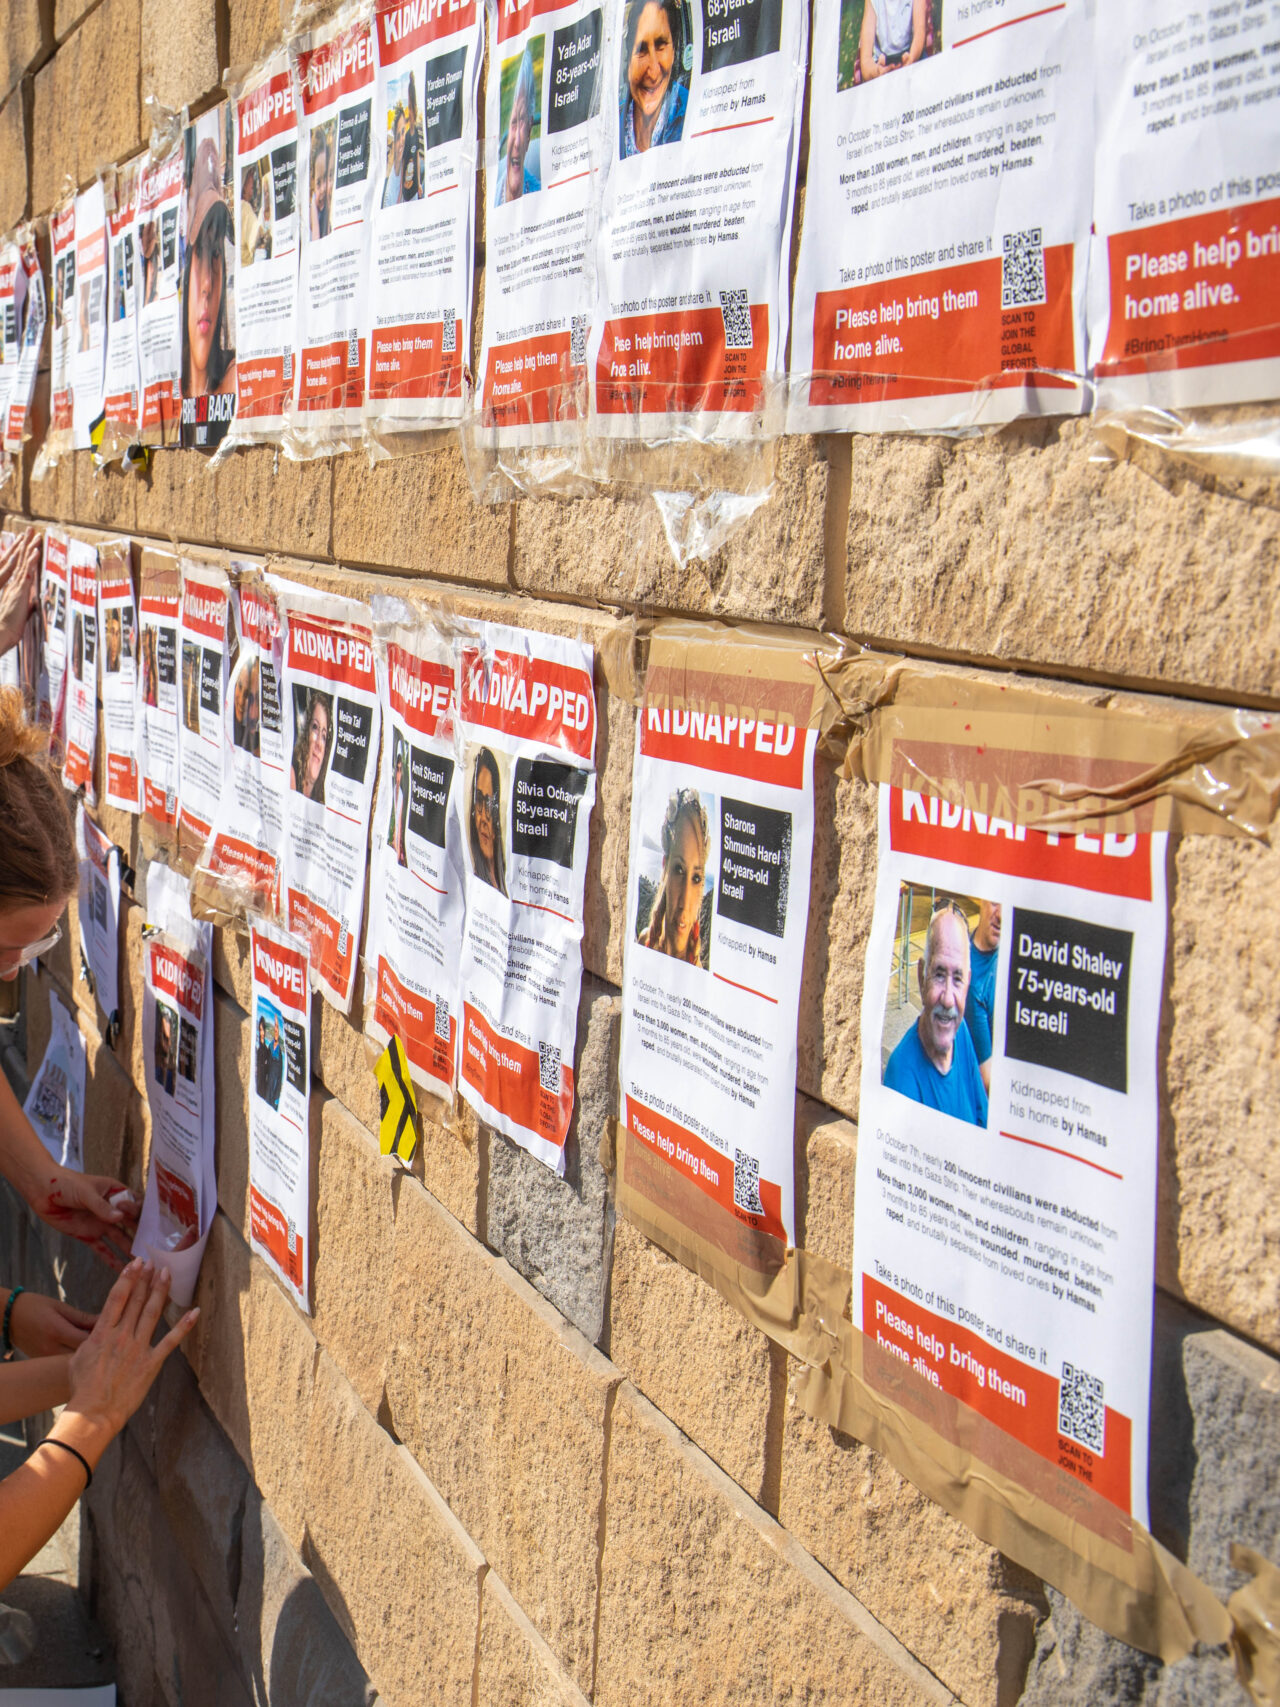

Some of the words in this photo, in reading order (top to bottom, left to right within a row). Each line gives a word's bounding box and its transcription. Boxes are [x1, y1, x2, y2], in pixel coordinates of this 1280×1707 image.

[558, 43, 576, 60] Yafa
[577, 34, 592, 52] Adar
[708, 19, 740, 47] Israeli
[556, 51, 600, 84] 85-years-old
[554, 85, 580, 108] Israeli
[730, 99, 740, 111] by
[742, 94, 766, 108] Hamas
[916, 100, 943, 120] innocent
[944, 91, 974, 110] civilians
[976, 84, 992, 98] were
[995, 68, 1037, 92] abducted
[719, 163, 750, 178] abducted
[840, 173, 856, 186] More
[857, 168, 870, 180] than
[928, 144, 941, 158] and
[990, 164, 999, 177] by
[1129, 203, 1155, 221] Take
[1159, 200, 1166, 214] a
[1170, 190, 1206, 215] photo
[1210, 182, 1224, 202] of
[1228, 176, 1252, 198] this
[1256, 172, 1280, 196] pos
[840, 268, 856, 284] Take
[864, 264, 884, 280] photo
[886, 260, 893, 274] of
[895, 256, 908, 271] this
[910, 250, 936, 270] poster
[938, 246, 954, 261] and
[958, 240, 984, 258] share
[986, 236, 992, 252] it
[1126, 250, 1188, 281] Please
[1194, 236, 1240, 269] help
[1246, 225, 1280, 258] bri
[620, 300, 639, 313] photo
[658, 296, 677, 310] poster
[836, 308, 878, 330] Please
[880, 300, 904, 324] help
[906, 295, 939, 320] bring
[942, 290, 978, 312] them
[1125, 292, 1179, 320] home
[1184, 280, 1240, 311] alive.
[1001, 314, 1021, 326] SCAN
[1023, 312, 1034, 322] TO
[376, 340, 392, 354] Please
[414, 337, 432, 350] them
[653, 330, 679, 350] bring
[834, 340, 872, 360] home
[875, 334, 904, 356] alive.
[1001, 329, 1018, 340] JOIN
[1020, 327, 1036, 338] THE
[496, 358, 514, 374] Please
[537, 352, 558, 366] them
[1001, 344, 1032, 356] GLOBAL
[1001, 357, 1038, 370] EFFORTS
[208, 394, 234, 422] BACK
[293, 627, 372, 674] KIDNAPPED
[648, 692, 796, 756] KIDNAPPED
[412, 760, 422, 778] Amit
[424, 766, 444, 785] Shani
[516, 780, 543, 798] Silvia
[516, 800, 575, 824] 58-years-ol
[724, 813, 756, 836] Sharona
[516, 819, 548, 836] Israeli
[724, 835, 756, 858] Shmunis
[758, 844, 780, 865] Harel
[722, 858, 768, 885] 40-years-old
[722, 879, 744, 900] Israeli
[508, 932, 535, 946] civilians
[758, 948, 776, 965] Hamas
[1020, 934, 1068, 966] David
[1072, 946, 1123, 980] Shalev
[1017, 968, 1116, 1015] 75-years-old
[407, 1004, 423, 1021] them
[1015, 1002, 1067, 1036] Israeli
[488, 1043, 500, 1067] bring
[501, 1054, 522, 1074] them
[630, 1082, 644, 1098] Take
[649, 1094, 665, 1111] photo
[672, 1104, 683, 1120] this
[684, 1114, 700, 1130] poster
[1010, 1080, 1068, 1110] Kidnapped
[1072, 1096, 1091, 1117] from
[1010, 1095, 1024, 1114] his
[1028, 1102, 1059, 1129] home
[1062, 1116, 1074, 1136] by
[1077, 1123, 1107, 1147] Hamas
[632, 1114, 656, 1144] Please
[657, 1131, 674, 1158] help
[676, 1142, 700, 1175] bring
[700, 1158, 719, 1186] them
[944, 1160, 956, 1174] 200
[958, 1166, 991, 1190] innocent
[993, 1182, 1032, 1204] civilians
[1035, 1197, 1058, 1214] were
[1060, 1207, 1099, 1232] abducted
[877, 1168, 890, 1184] More
[892, 1176, 906, 1190] than
[908, 1184, 928, 1200] 3,000
[929, 1194, 956, 1216] women,
[958, 1208, 974, 1224] men,
[976, 1218, 988, 1231] and
[1034, 1242, 1068, 1266] ranging
[980, 1196, 1034, 1224] whereabouts
[1037, 1216, 1068, 1235] remain
[922, 1224, 948, 1246] brutally
[1000, 1262, 1024, 1282] loved
[1026, 1275, 1050, 1292] ones
[1052, 1283, 1064, 1300] by
[980, 1238, 1020, 1264] wounded,
[874, 1260, 892, 1282] Take
[900, 1276, 924, 1300] photo
[926, 1290, 934, 1304] of
[936, 1295, 956, 1316] this
[958, 1306, 984, 1331] poster
[986, 1325, 1002, 1344] and
[1006, 1335, 1036, 1360] share
[1040, 1347, 1047, 1366] it
[876, 1300, 914, 1340] Please
[916, 1325, 944, 1362] help
[950, 1342, 986, 1386] bring
[988, 1369, 1026, 1407] them
[876, 1330, 910, 1365] home
[912, 1357, 944, 1390] alive.
[1058, 1440, 1080, 1459] SCAN
[1082, 1450, 1093, 1466] TO
[1058, 1456, 1078, 1474] JOIN
[1078, 1466, 1092, 1482] THE
